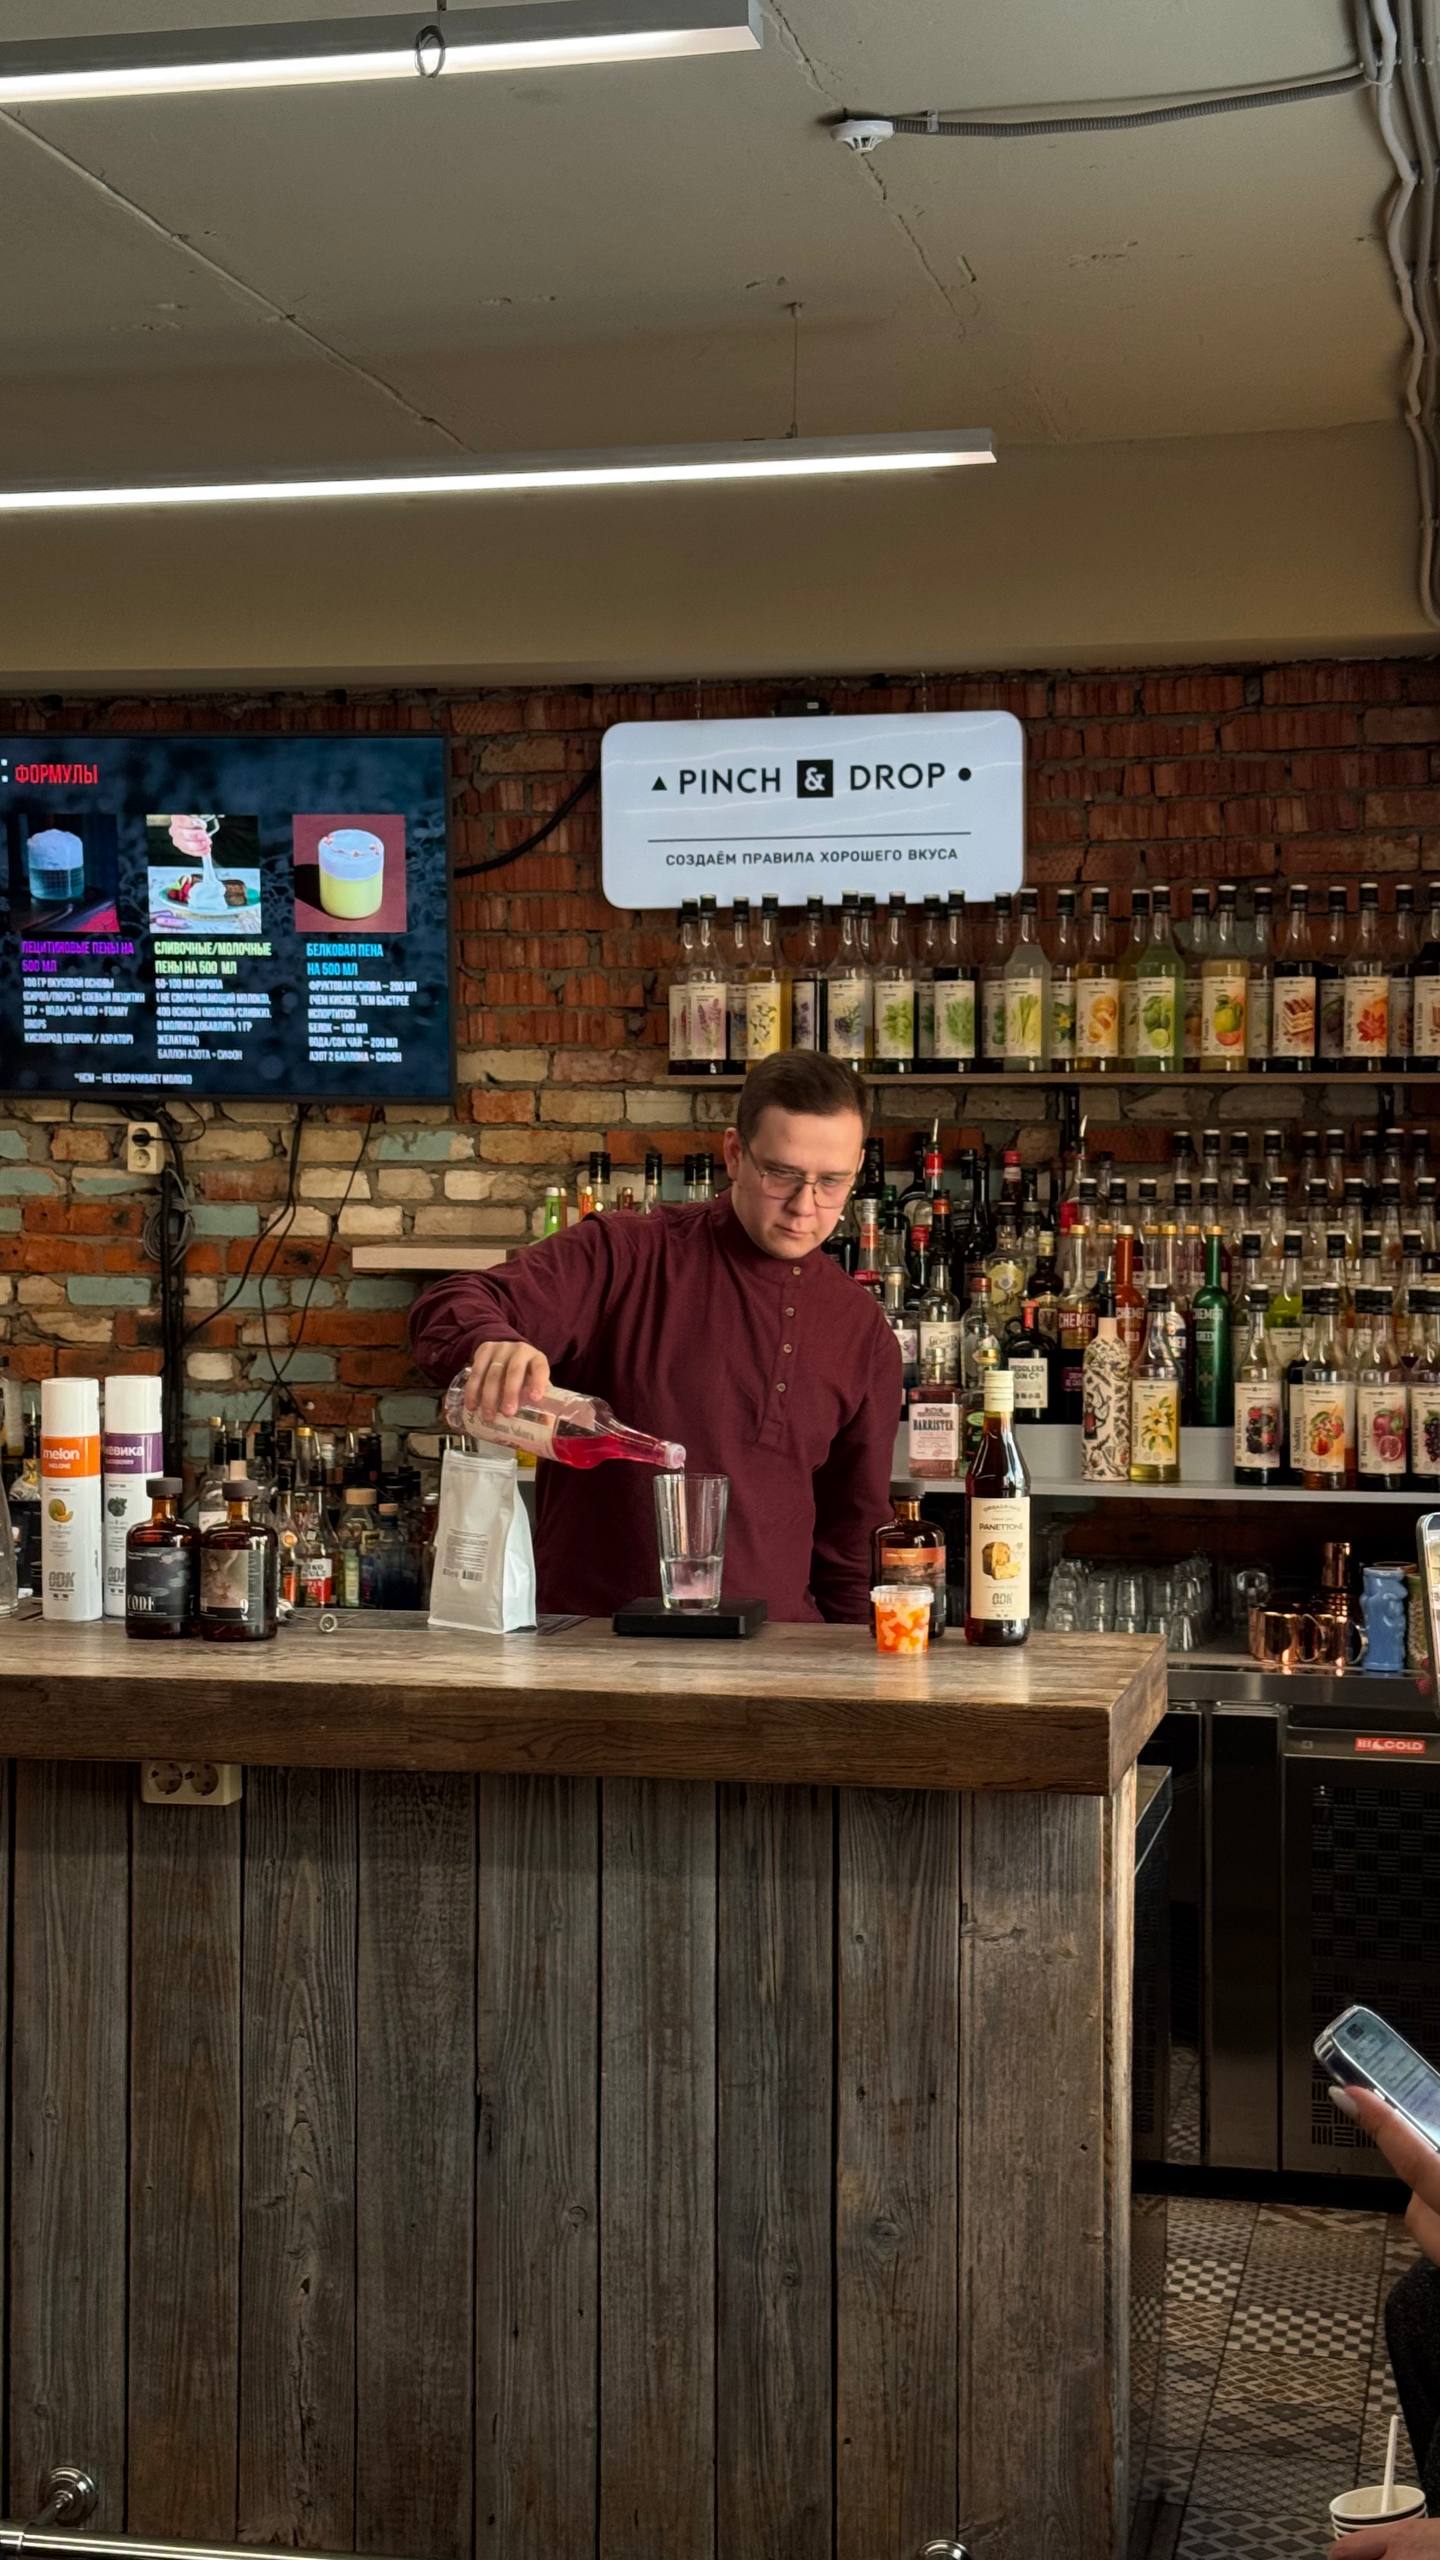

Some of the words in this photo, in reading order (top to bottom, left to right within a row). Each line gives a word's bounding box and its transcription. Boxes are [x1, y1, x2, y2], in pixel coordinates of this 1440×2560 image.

[15, 764, 98, 784] ФОРМУЛЫ
[679, 767, 781, 795] PINCH
[803, 766, 827, 792] &
[850, 762, 946, 791] DROP
[666, 851, 736, 868] СОЗДАЁМ
[742, 852, 815, 865] ПРАВИЛА
[820, 849, 902, 863] ХОРОШЕГО
[908, 848, 958, 861] ВКУСА
[154, 941, 272, 956] СЛИВОЧНЫЕ/МОЛОЧНЫЕ
[306, 943, 356, 957] БЕЛКОВАЯ
[358, 943, 384, 957] ПЕНА
[155, 961, 183, 974] ПЕНЫ
[184, 961, 198, 974] НА
[199, 961, 218, 974] 500
[221, 961, 237, 974] МЛ
[307, 962, 320, 976] НА
[322, 962, 340, 976] 500
[342, 962, 358, 976] МЛ
[912, 1419, 955, 1431] BARRISTER
[43, 1448, 80, 1461] melon
[105, 1446, 145, 1457] евика
